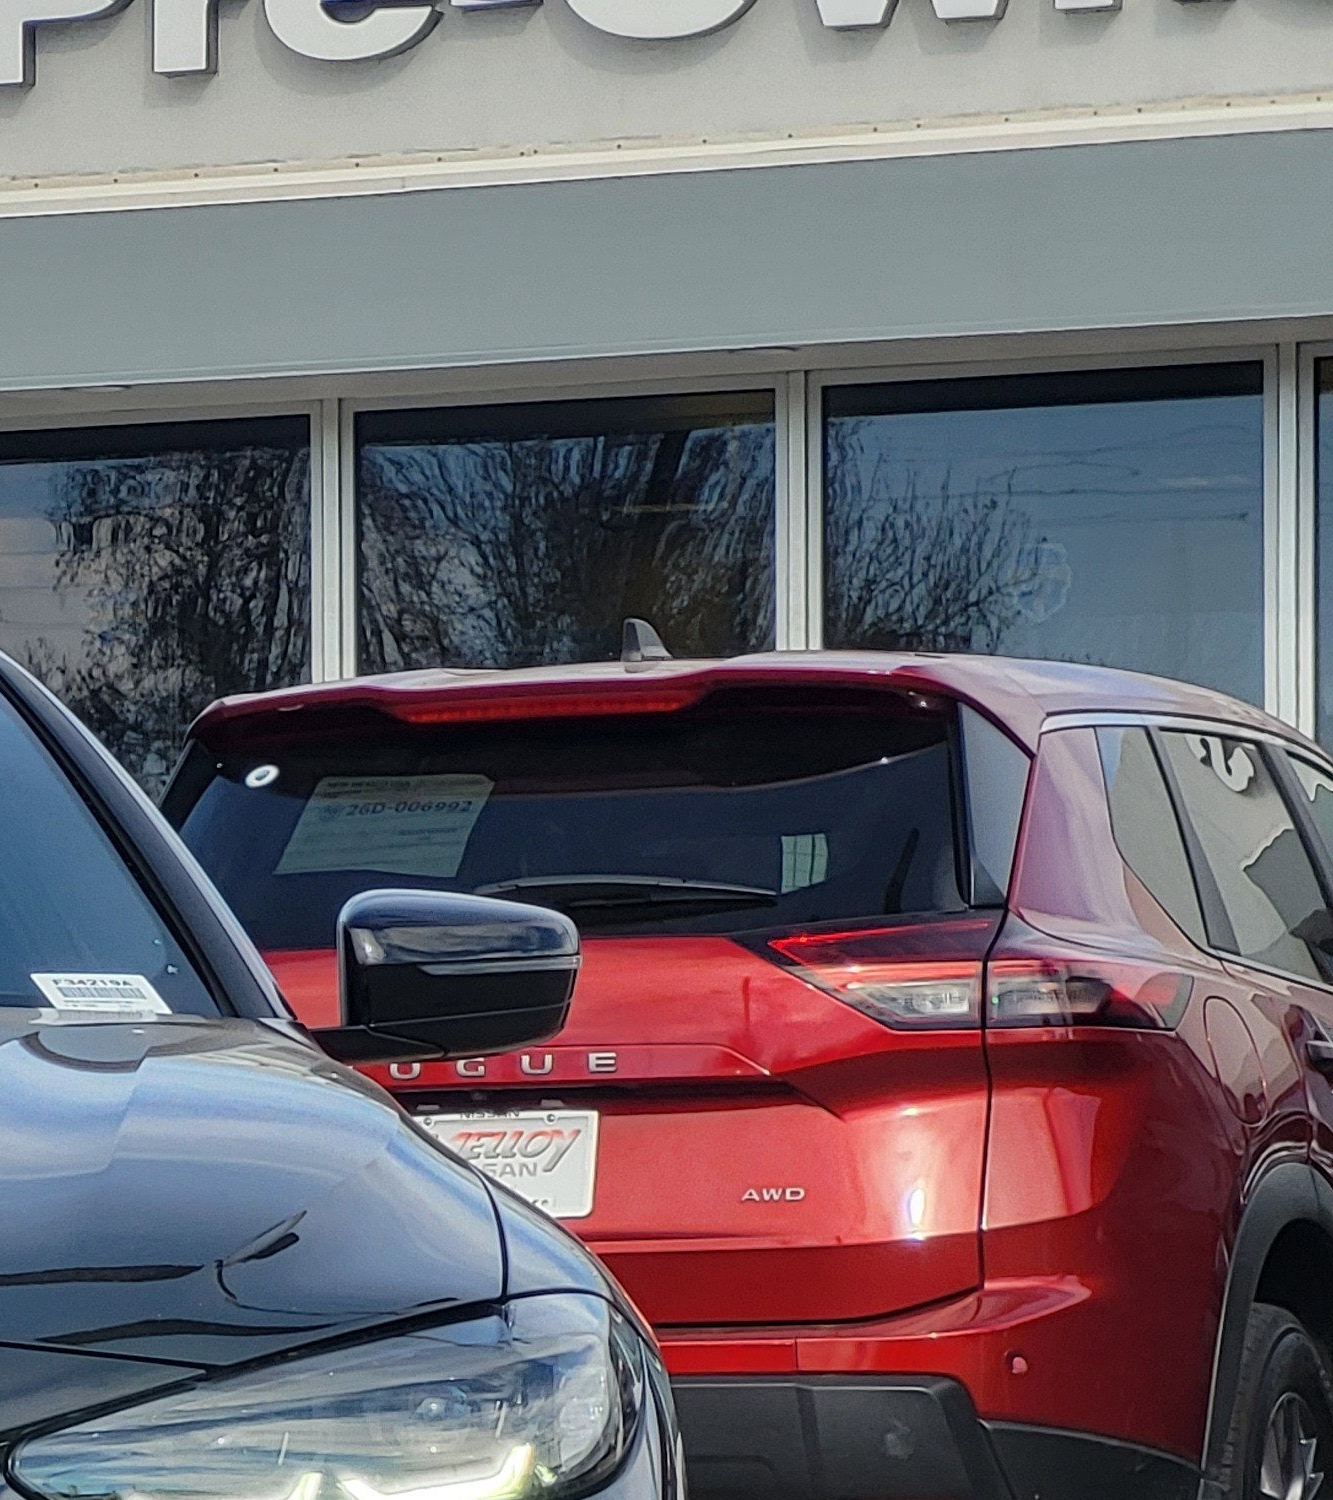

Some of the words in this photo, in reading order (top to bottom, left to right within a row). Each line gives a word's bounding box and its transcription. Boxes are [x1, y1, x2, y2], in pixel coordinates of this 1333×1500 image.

[389, 1052, 617, 1079] OGUE
[451, 1129, 582, 1172] ELLOY
[741, 1187, 806, 1202] AWD
